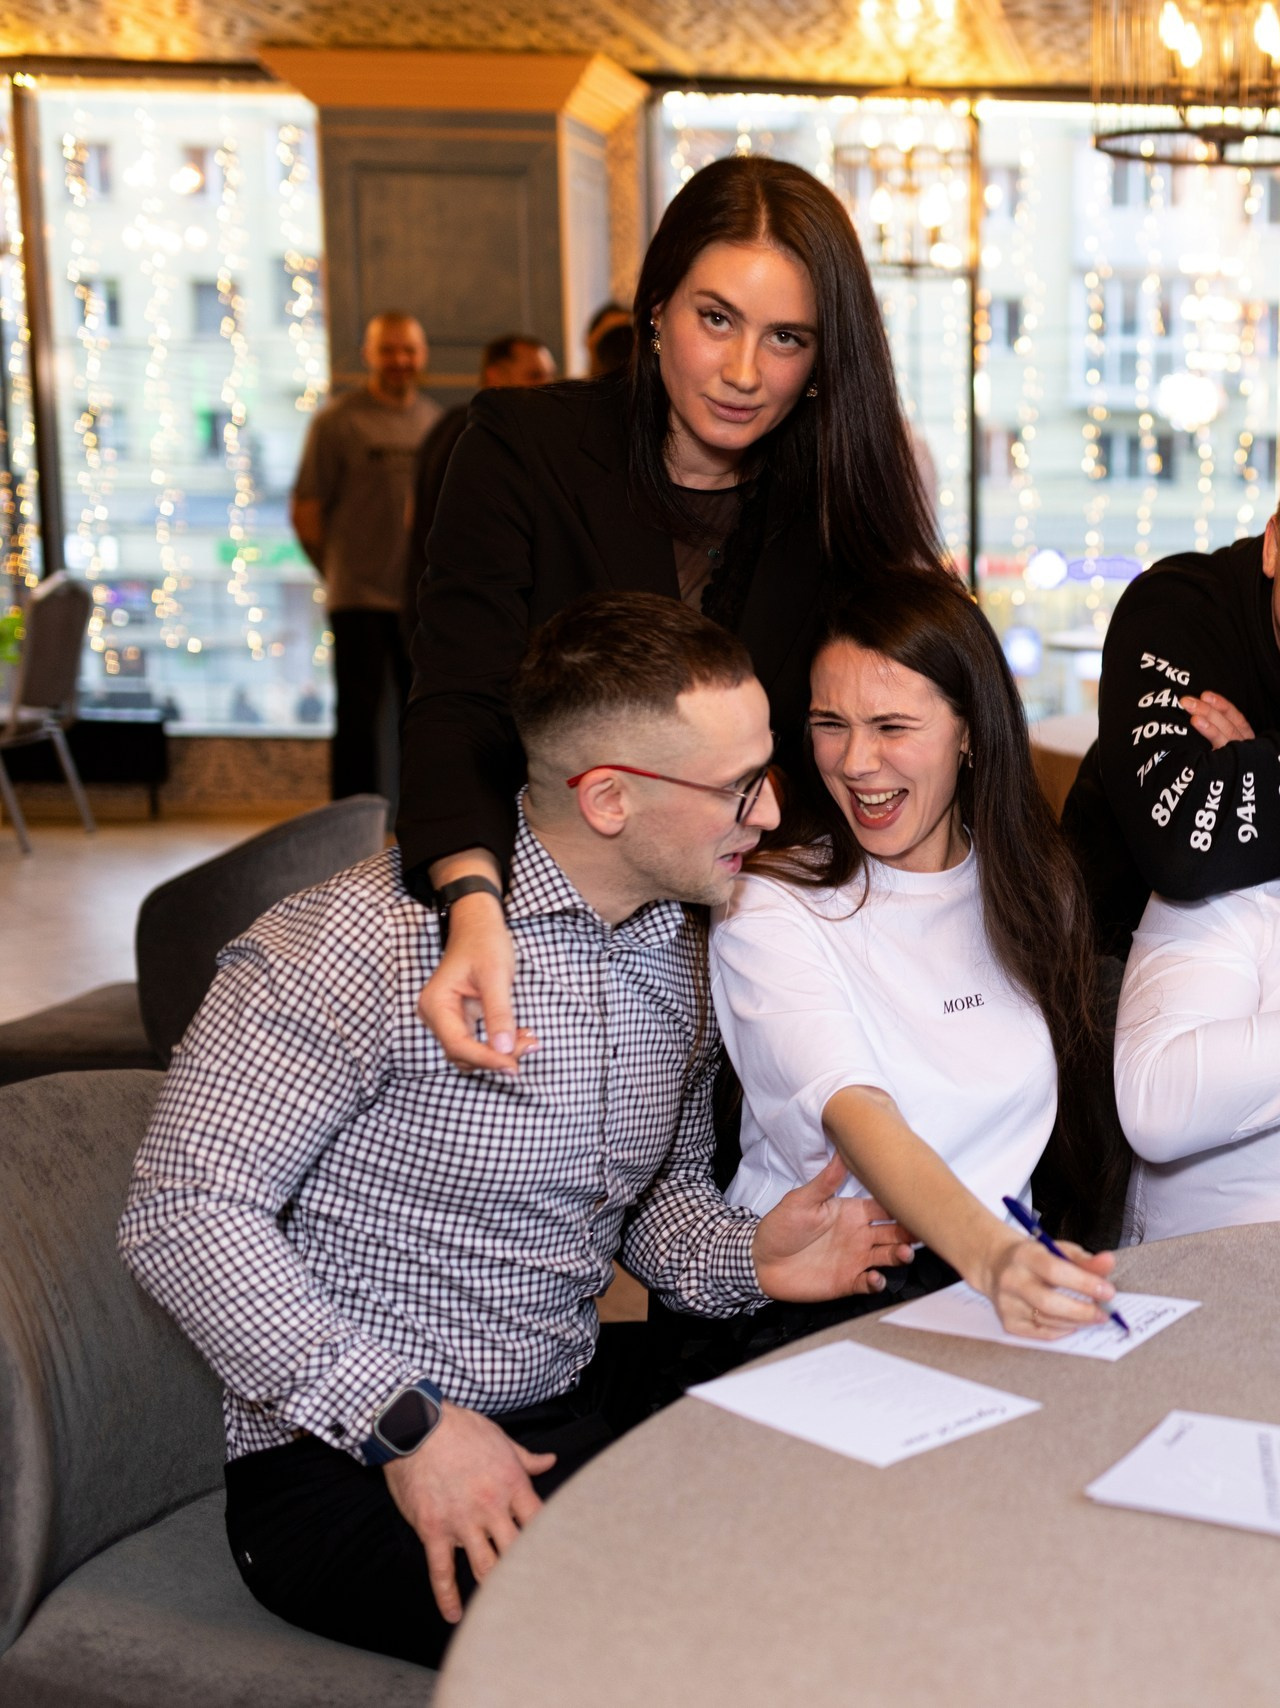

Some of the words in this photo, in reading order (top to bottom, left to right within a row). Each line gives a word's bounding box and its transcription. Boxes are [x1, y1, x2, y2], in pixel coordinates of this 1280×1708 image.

[1140, 652, 1190, 686] 57KG
[1137, 688, 1185, 710] 64K
[1151, 766, 1195, 827] 82KG
[1189, 780, 1224, 852] 88KG
[1236, 772, 1259, 843] 94KG
[943, 993, 985, 1014] MORE
